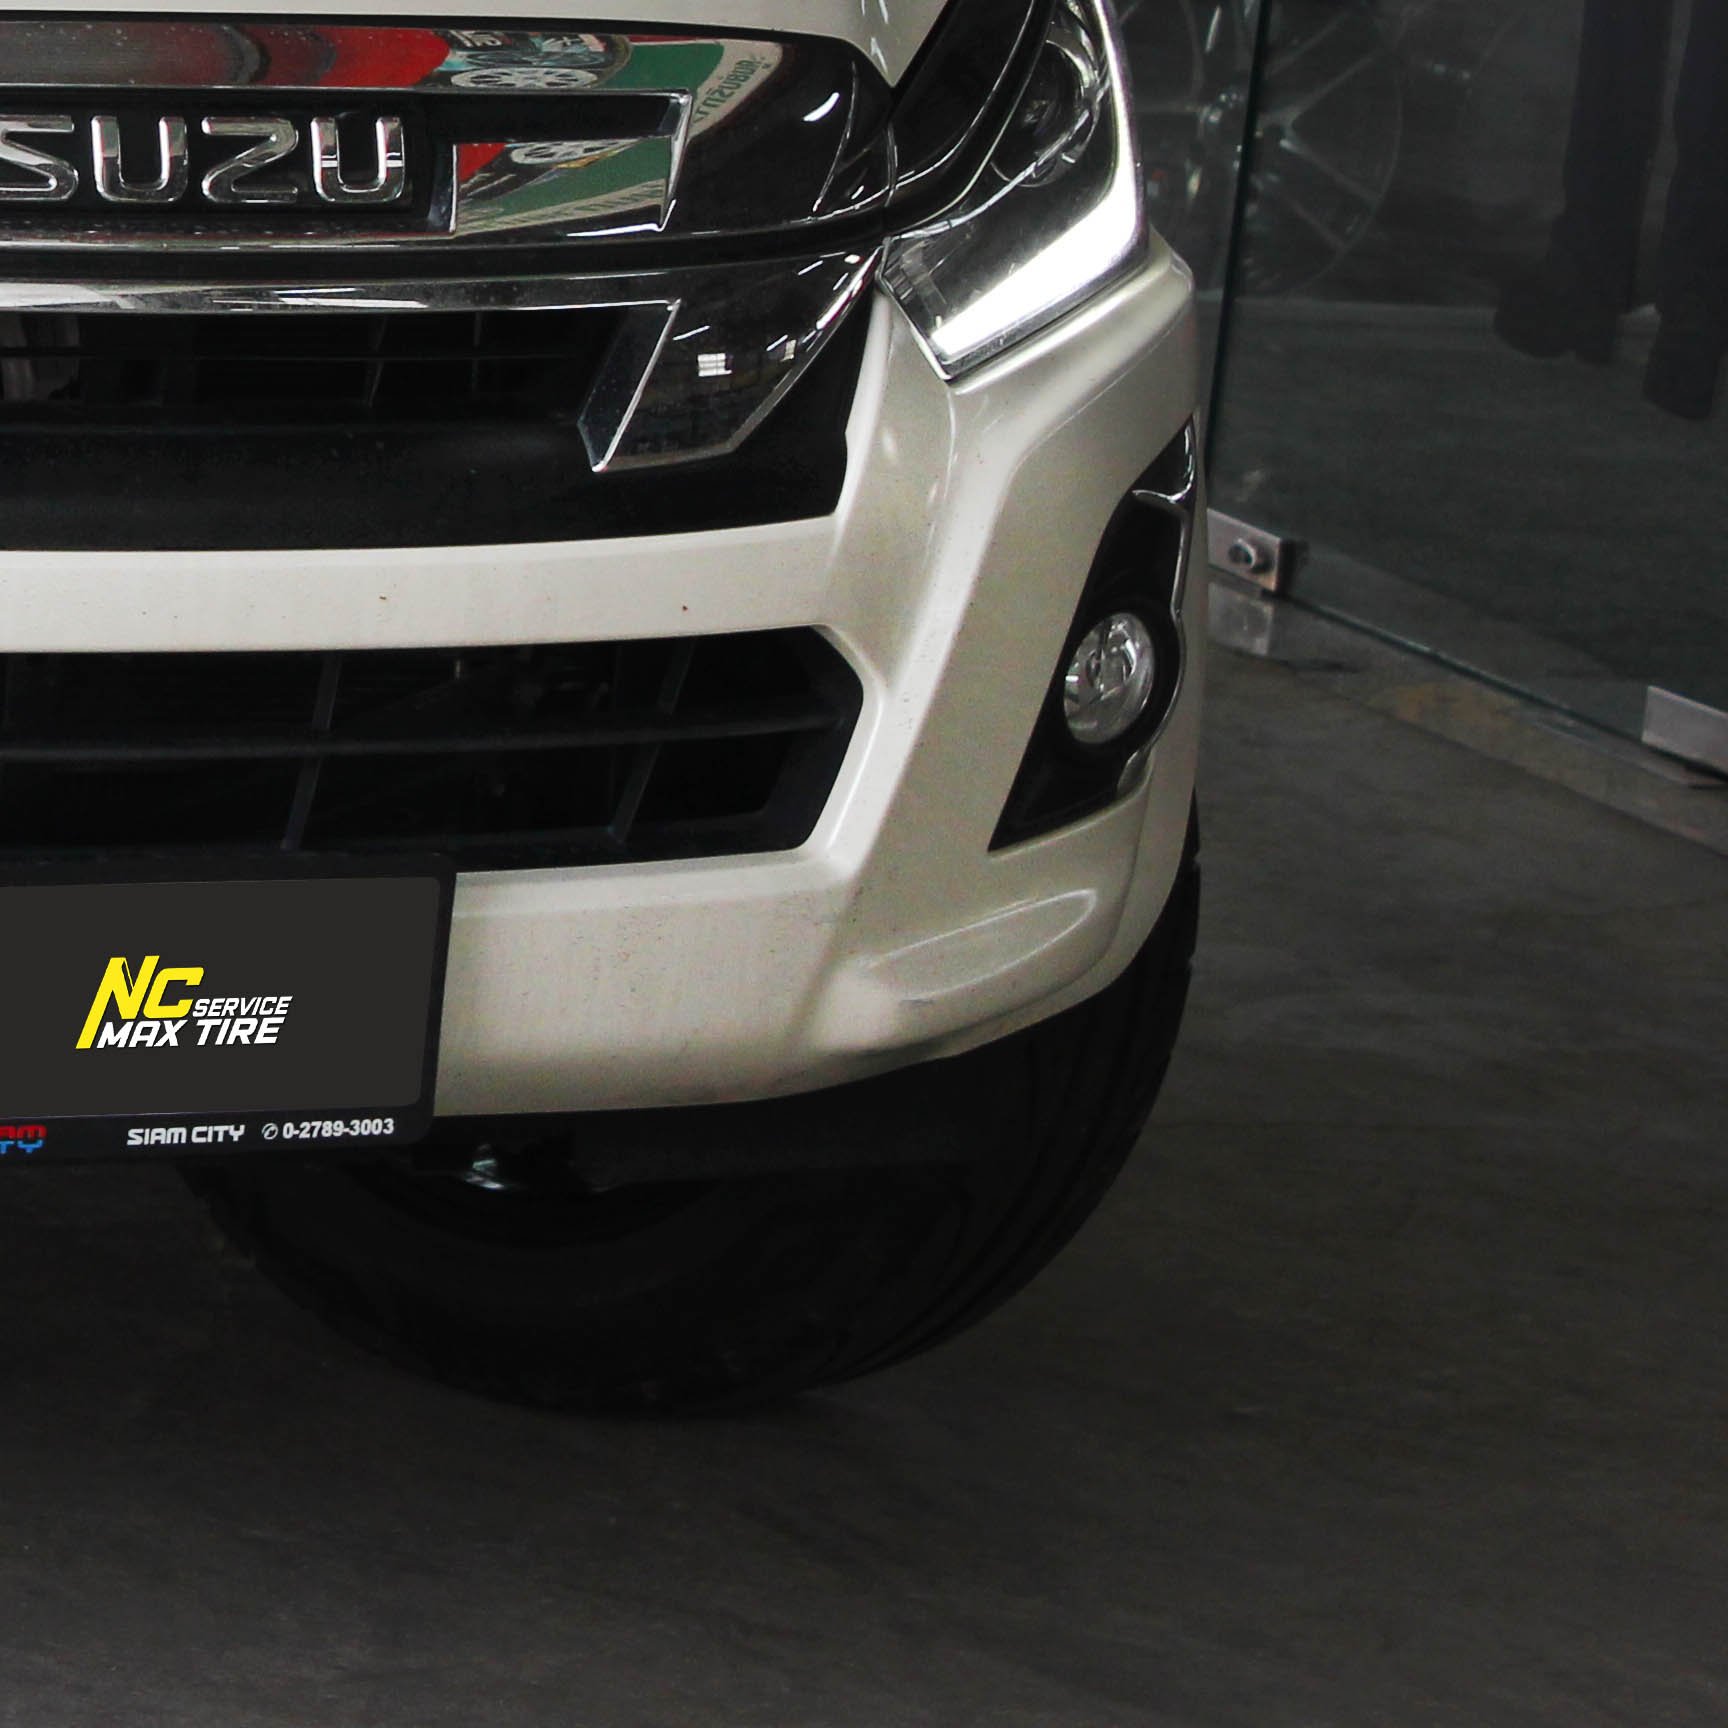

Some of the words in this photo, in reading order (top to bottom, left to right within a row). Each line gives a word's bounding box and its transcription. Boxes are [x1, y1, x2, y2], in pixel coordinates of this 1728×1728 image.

[126, 1126, 187, 1146] SIAM
[192, 1124, 246, 1143] CITY
[282, 1118, 395, 1139] 0-2789-3003
